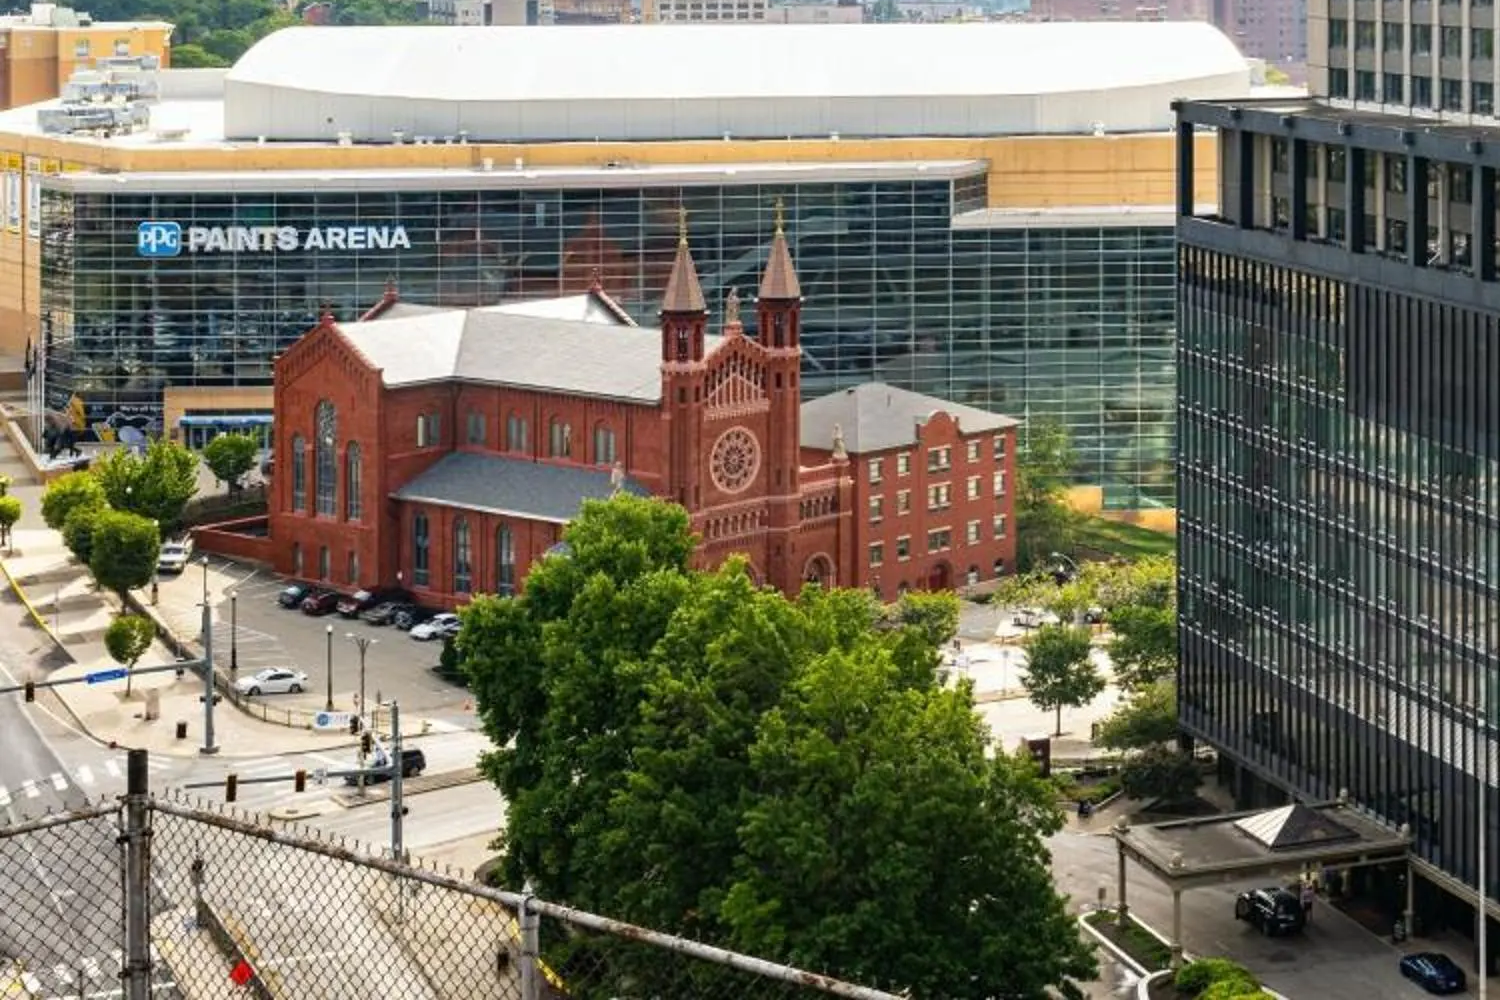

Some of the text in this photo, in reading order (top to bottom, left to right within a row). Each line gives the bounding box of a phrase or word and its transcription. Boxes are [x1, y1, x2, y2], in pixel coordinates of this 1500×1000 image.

[139, 226, 412, 253] PPG PAINTS ARENA
